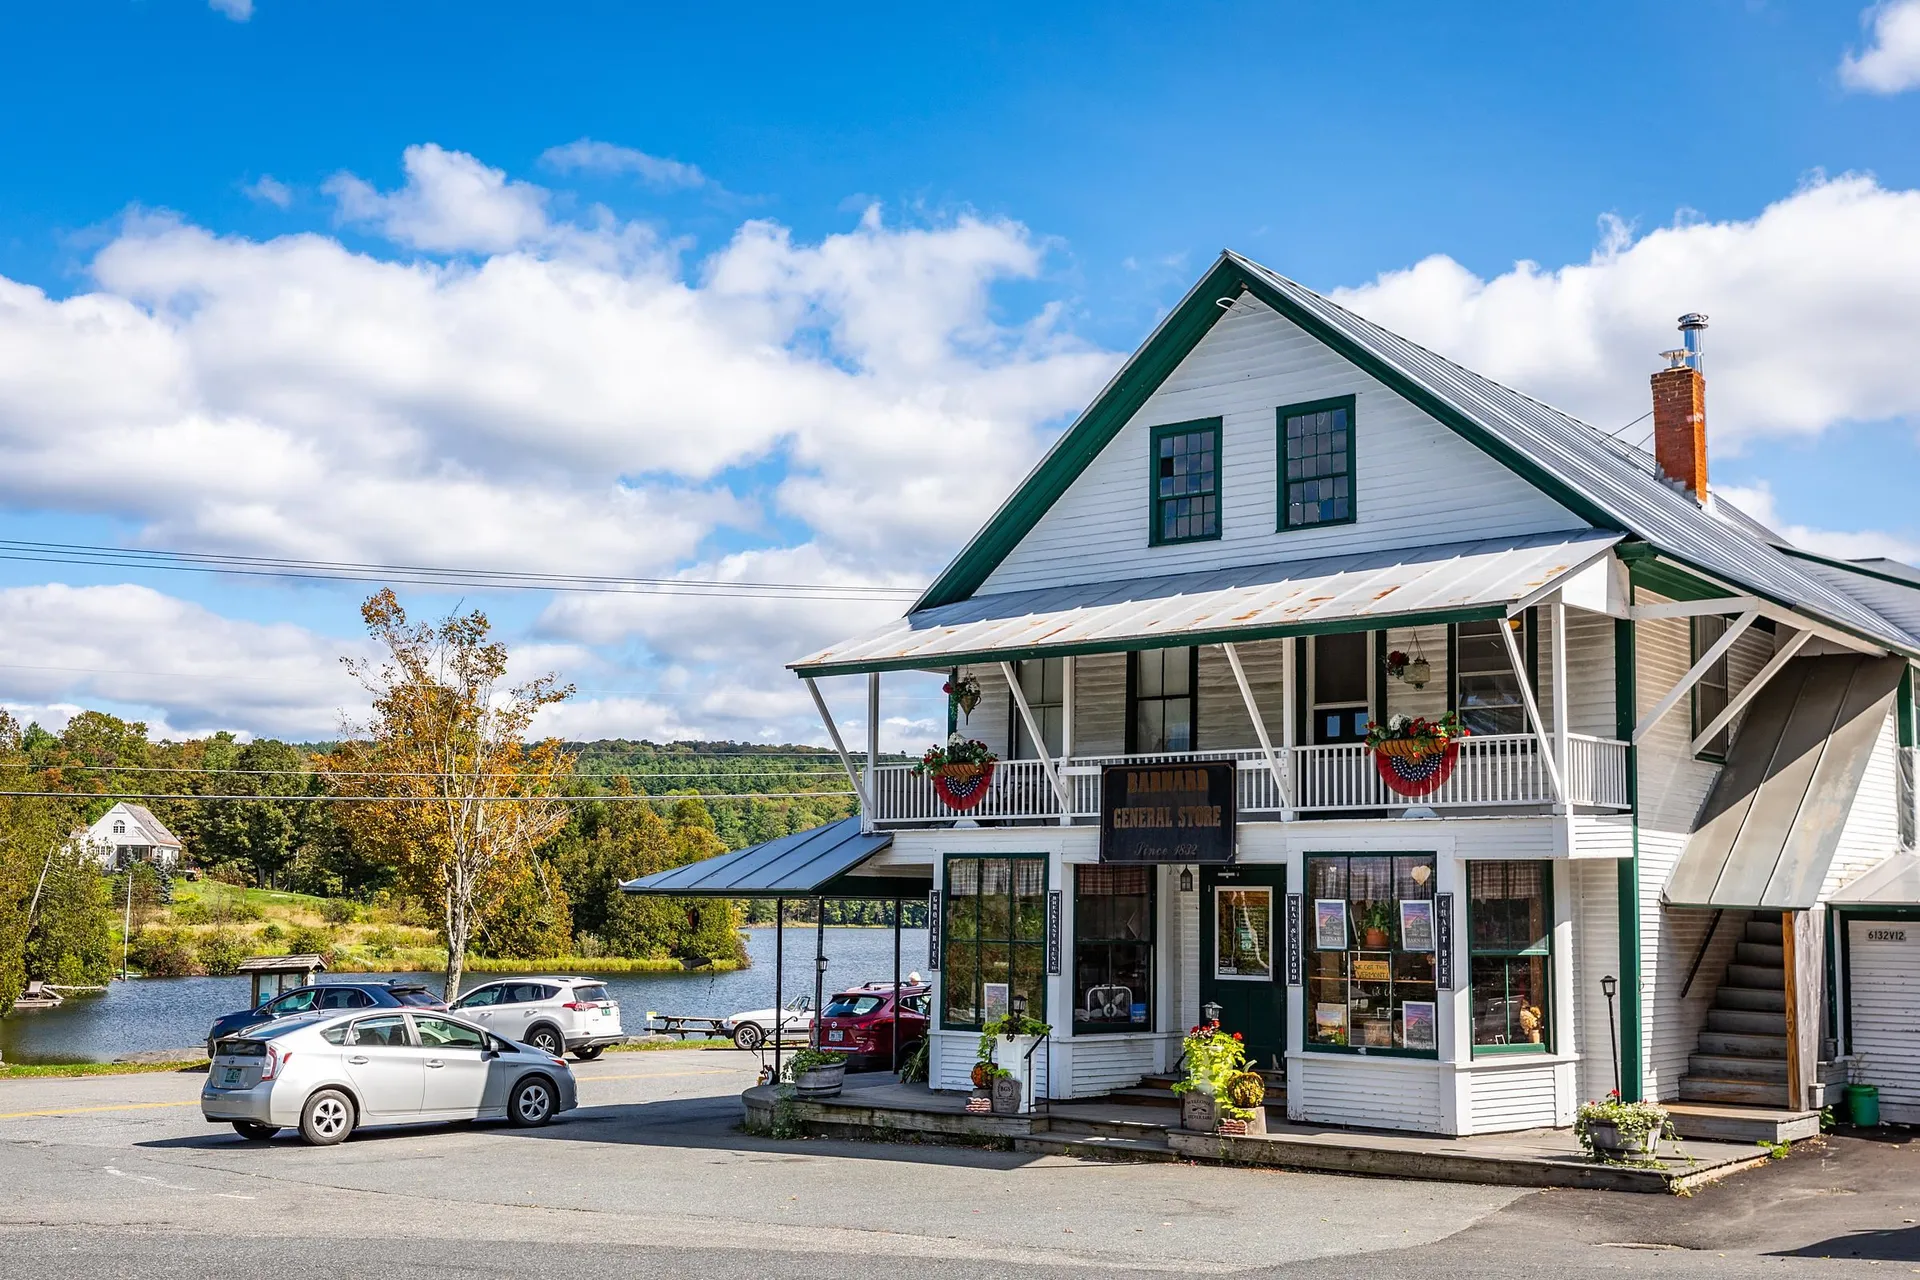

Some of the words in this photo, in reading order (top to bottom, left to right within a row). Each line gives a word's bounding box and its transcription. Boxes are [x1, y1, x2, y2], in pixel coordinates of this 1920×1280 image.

[1127, 769, 1209, 793] BARNARD
[1113, 806, 1173, 829] GENERAL
[1178, 805, 1222, 828] STORE
[1134, 841, 1168, 857] Since
[1174, 843, 1198, 856] 1832
[1868, 930, 1904, 941] 6132V12
